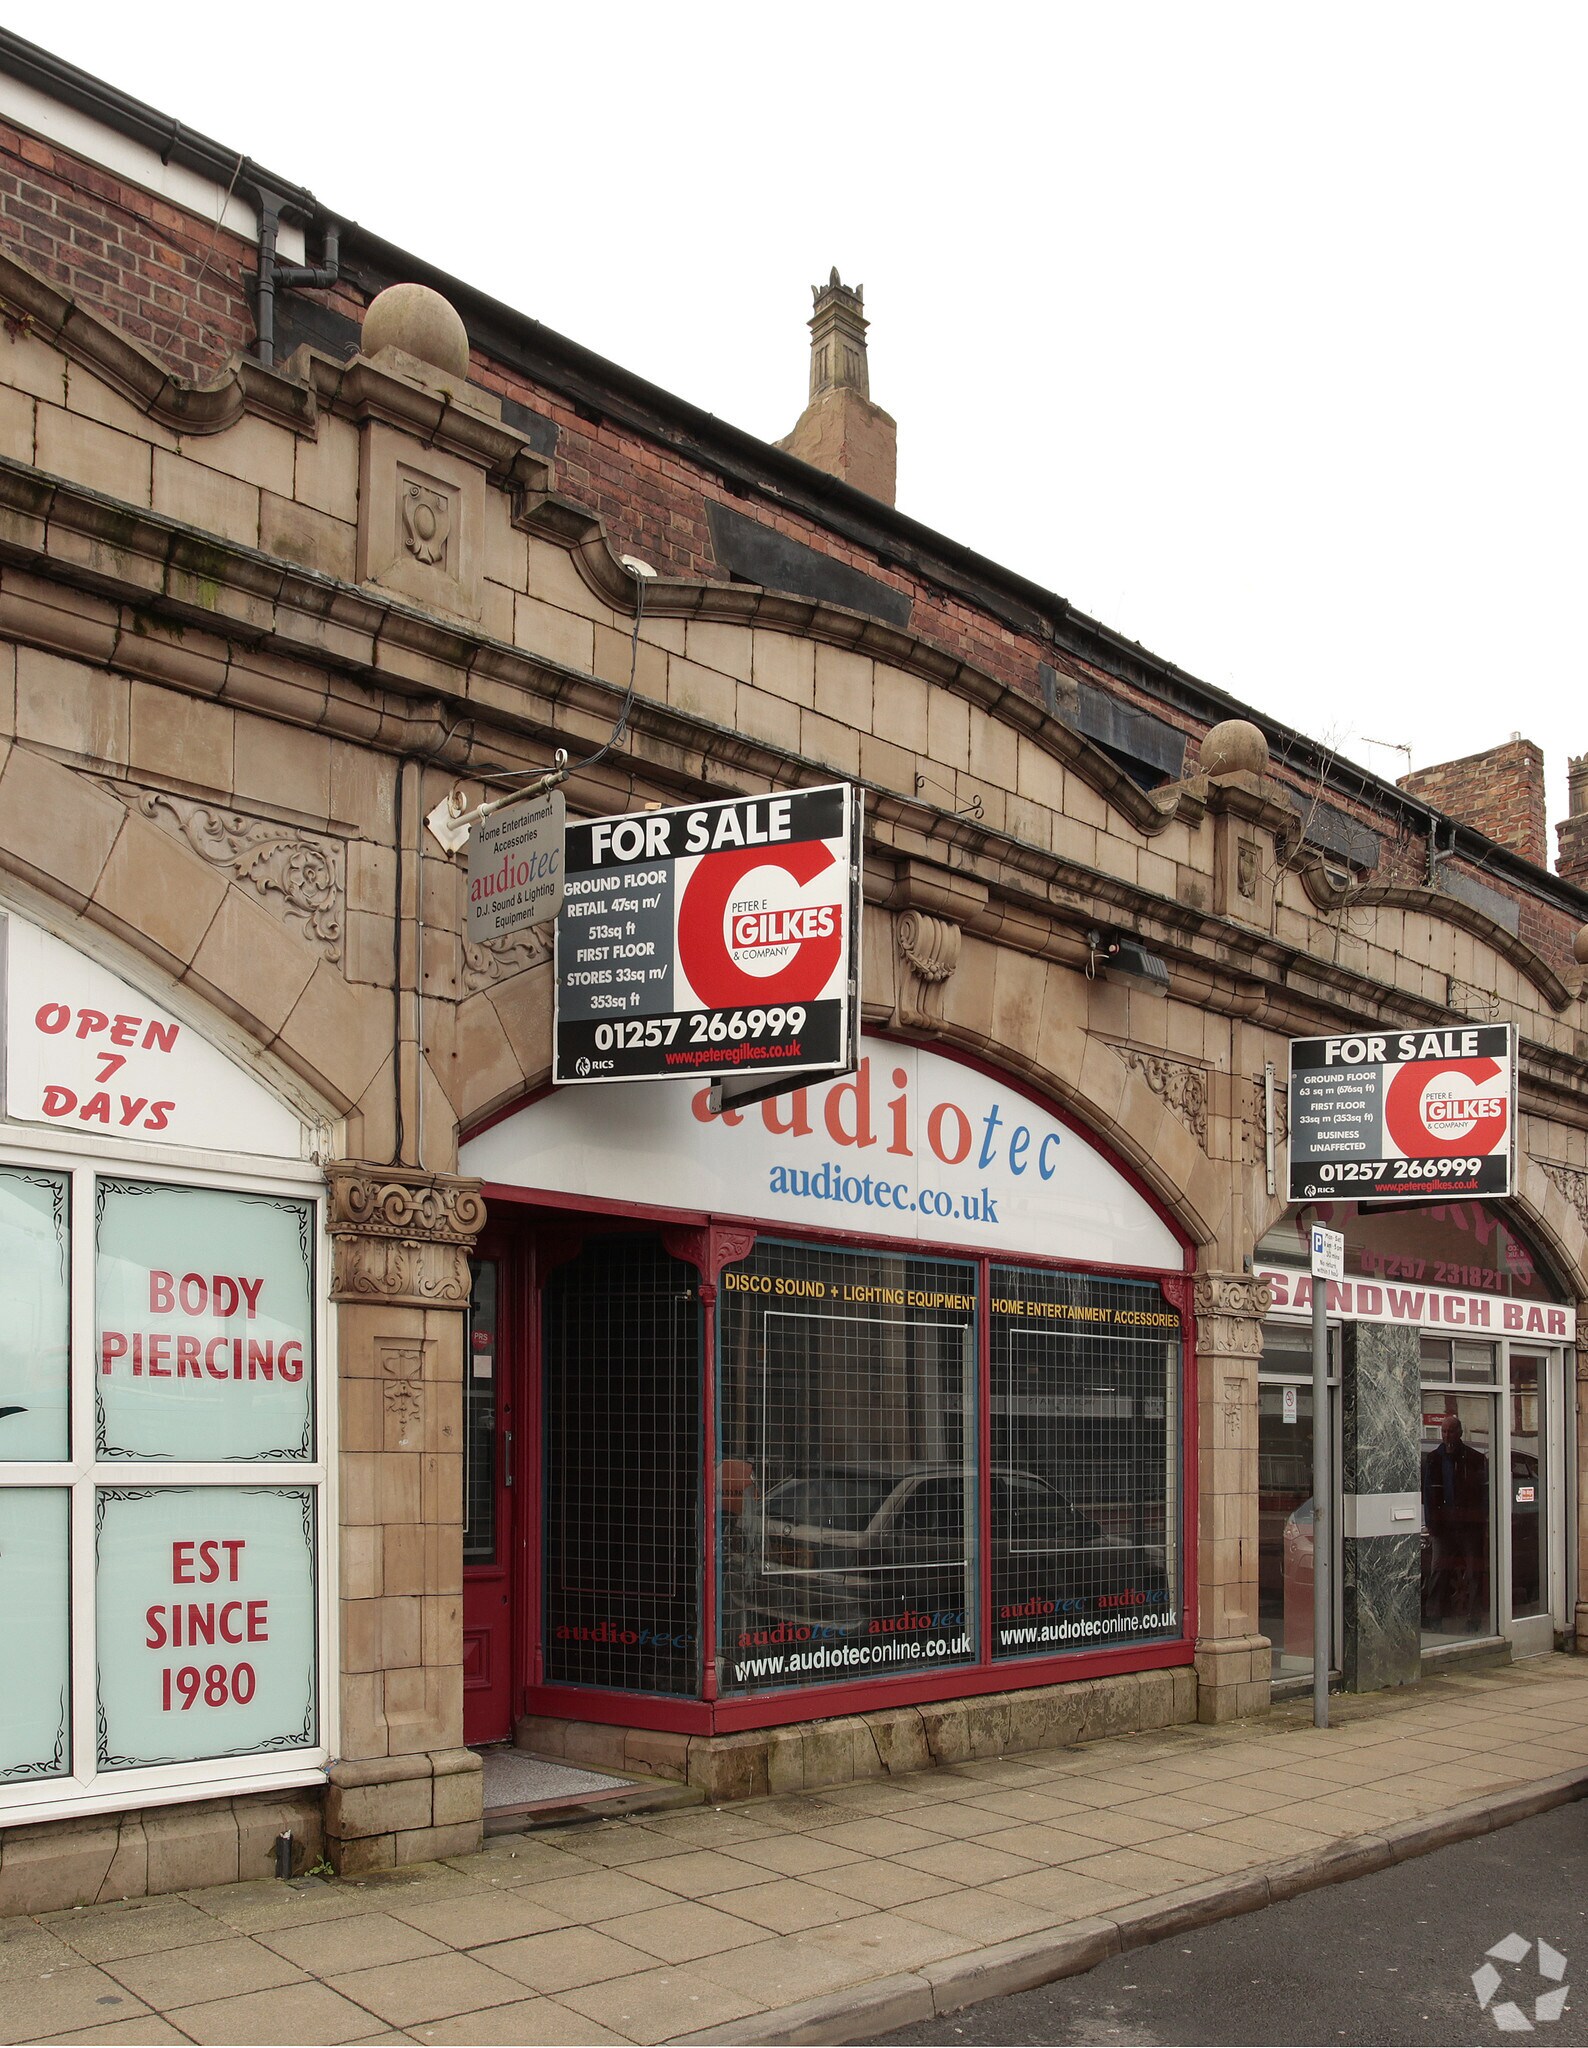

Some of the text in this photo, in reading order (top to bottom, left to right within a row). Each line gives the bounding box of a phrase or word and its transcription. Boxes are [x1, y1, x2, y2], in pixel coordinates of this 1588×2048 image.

[479, 805, 553, 843] Home Entertainment
[591, 799, 792, 865] FOR SALE
[493, 829, 538, 854] Accessories
[471, 847, 560, 902] audiotec
[563, 870, 667, 896] GROUND FLOOR
[476, 882, 555, 918] D.J. Sound & Lighting
[567, 893, 661, 918] RETAIL 47sq m/
[732, 899, 767, 913] PETER E
[495, 906, 534, 929] Equipment
[588, 921, 636, 940] 513sq ft
[736, 907, 834, 945] GILKES
[576, 942, 655, 962] FIRST FLOOR
[733, 946, 789, 960] & COMPANY
[567, 964, 668, 986] STORES 33sq m/
[590, 992, 640, 1010] 353sq ft
[35, 1002, 180, 1053] OPEN
[595, 1006, 807, 1050] 01257 266999
[665, 1039, 802, 1067] www.peteregilkes.co.uk
[1325, 1031, 1478, 1065] FOR SALE
[94, 1052, 127, 1084] 7
[592, 1059, 614, 1070] RICS
[1304, 1072, 1376, 1084] GROUND FLOOR
[1299, 1088, 1310, 1096] 63
[1337, 1085, 1363, 1096] (676sq
[1365, 1083, 1375, 1094] ft)
[1426, 1092, 1446, 1100] PETER
[41, 1085, 175, 1130] DAYS
[1299, 1116, 1320, 1124] 33sq
[1333, 1113, 1362, 1124] (353sq
[1364, 1113, 1374, 1122] ft)
[1310, 1101, 1366, 1111] FIRST FLOOR
[1429, 1099, 1502, 1120] GILKES
[1310, 1142, 1366, 1152] UNAFFECTED
[1317, 1130, 1360, 1140] BUSINESS
[1319, 1158, 1482, 1182] 01257 266999
[769, 1161, 1000, 1224] audiotec.co.uk
[1375, 1178, 1479, 1193] www.peteregilkes.co.uk
[1361, 1249, 1502, 1290] 01257 231821
[149, 1269, 265, 1320] BODY
[725, 1273, 977, 1311] DISCO SOUND + LIGHTING EQUIPMENT
[1259, 1272, 1566, 1336] SANDWICH BAR
[992, 1298, 1180, 1328] HOME ENTERTAINMENT ACCESSORIES
[102, 1330, 304, 1383] PIERCING
[171, 1539, 246, 1585] EST
[1000, 1596, 1088, 1618] audiotec
[145, 1599, 269, 1650] SINCE
[556, 1621, 693, 1648] audiotec
[738, 1621, 853, 1647] audiotec
[1000, 1608, 1176, 1646] www.audioteconline.co.uk
[734, 1633, 971, 1681] www.audioteconline.co.uk
[161, 1662, 257, 1712] 1980
